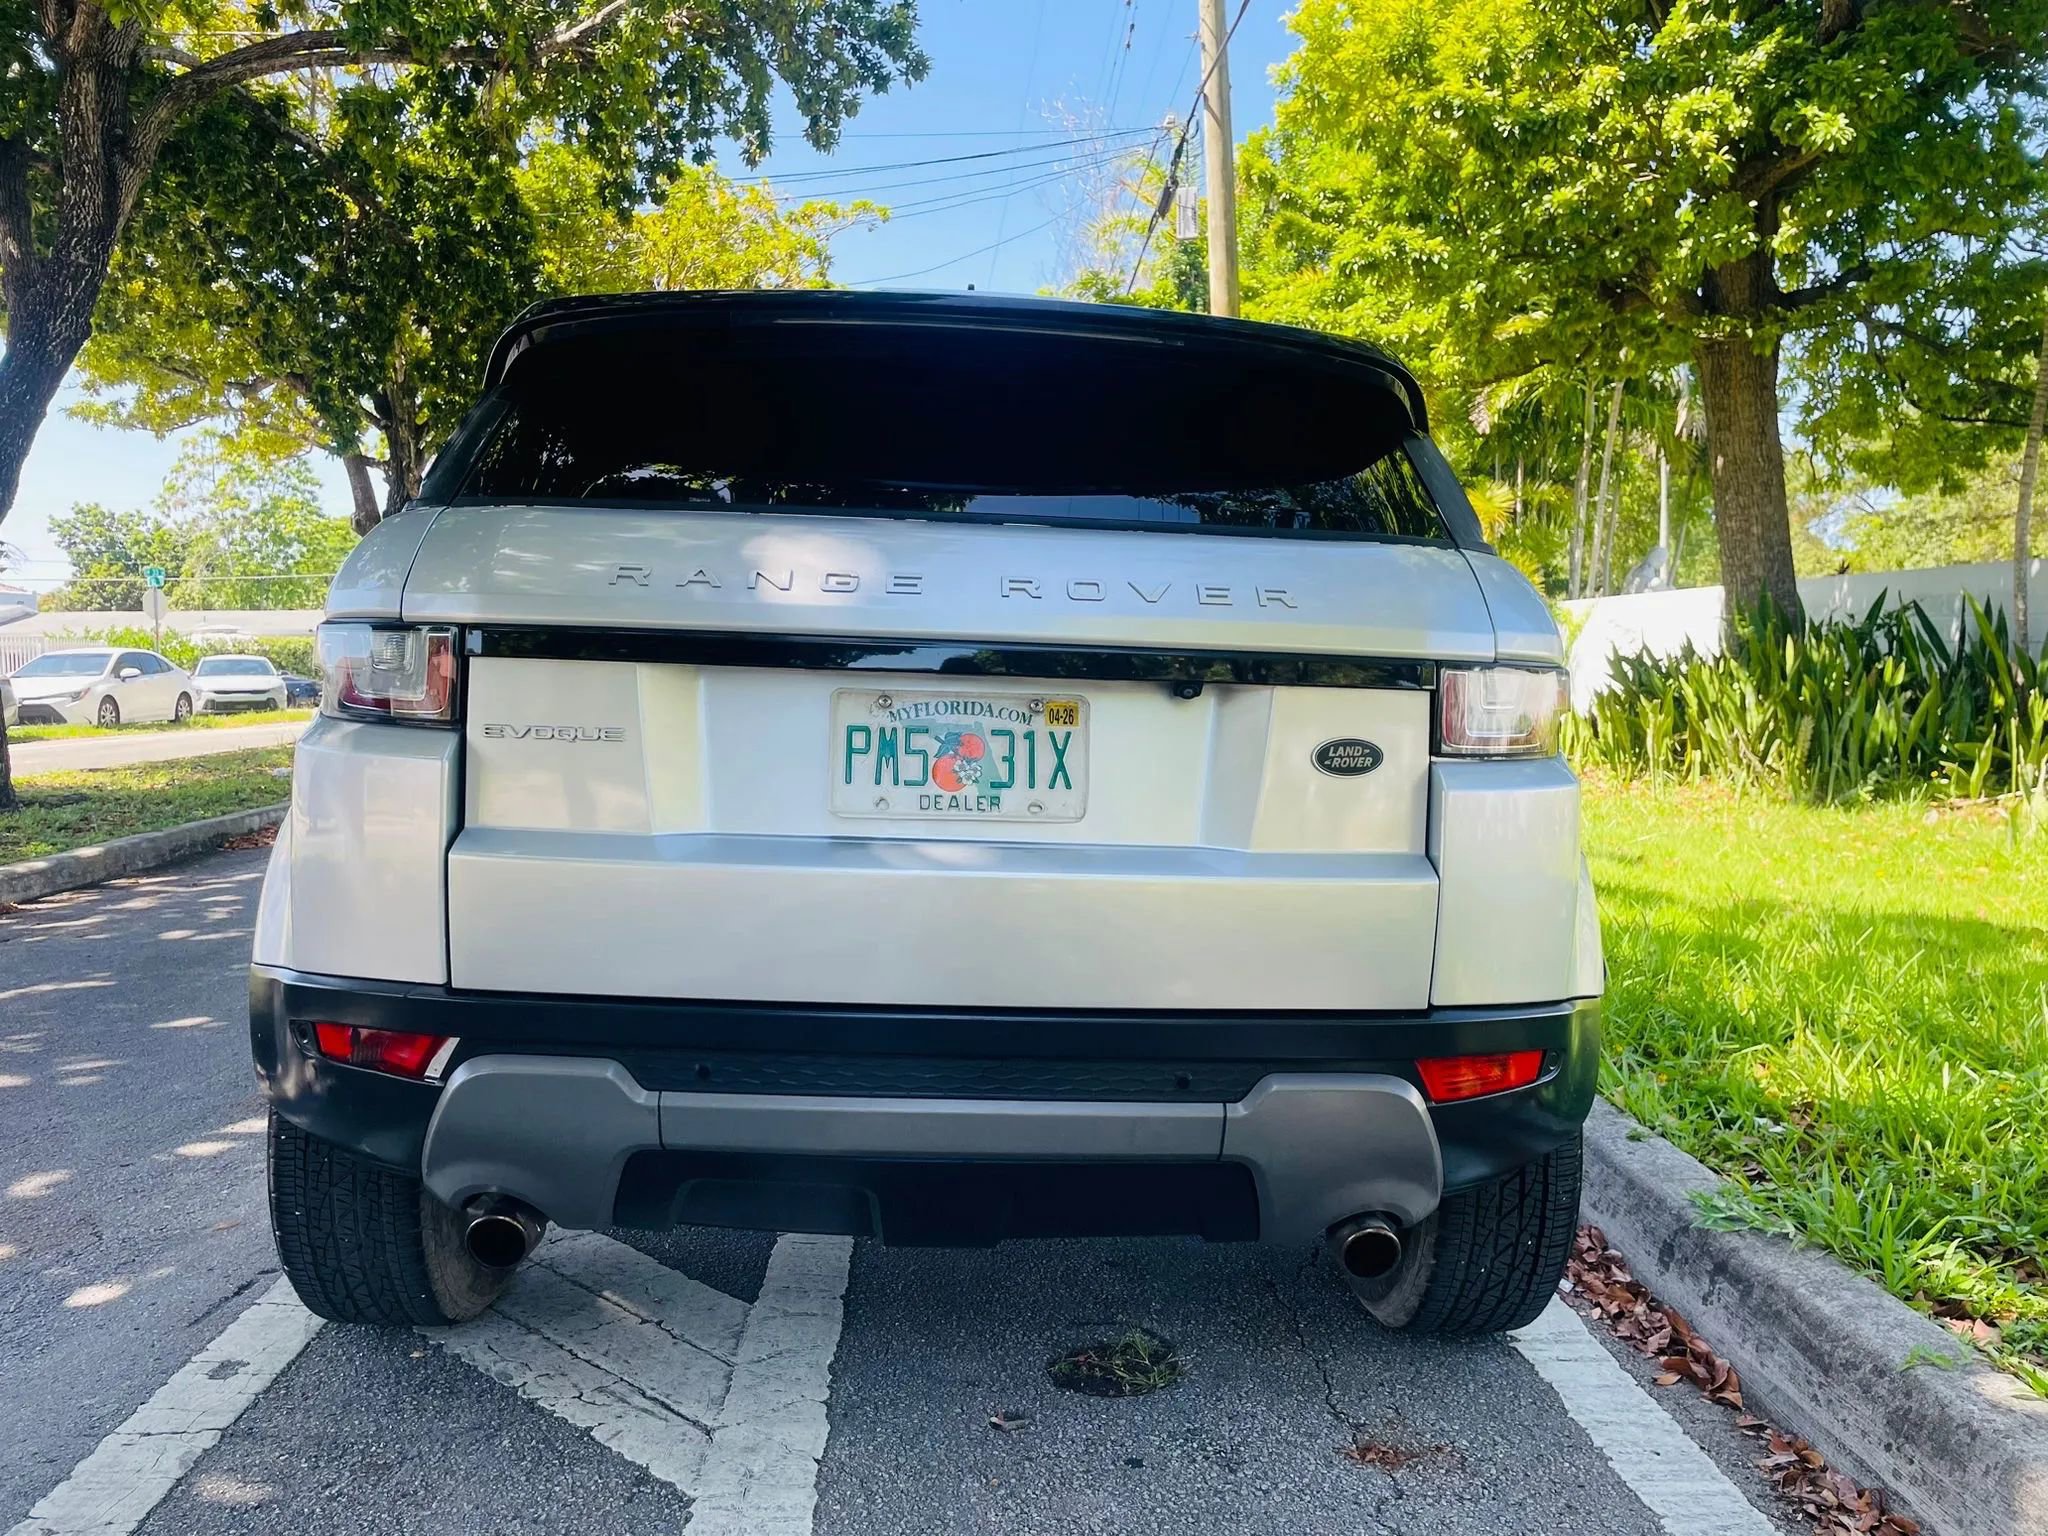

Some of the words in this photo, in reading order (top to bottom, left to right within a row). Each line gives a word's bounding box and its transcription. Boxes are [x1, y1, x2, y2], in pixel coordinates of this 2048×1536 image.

[609, 564, 923, 595] RANGE
[1000, 575, 1298, 608] ROVER
[889, 701, 1033, 726] MYFLORIDA.COM
[1049, 708, 1074, 725] 04-26
[483, 723, 625, 743] EVOQUE
[1328, 746, 1363, 757] LAND
[1331, 757, 1373, 768] ROVER
[919, 794, 1002, 812] DEALER
